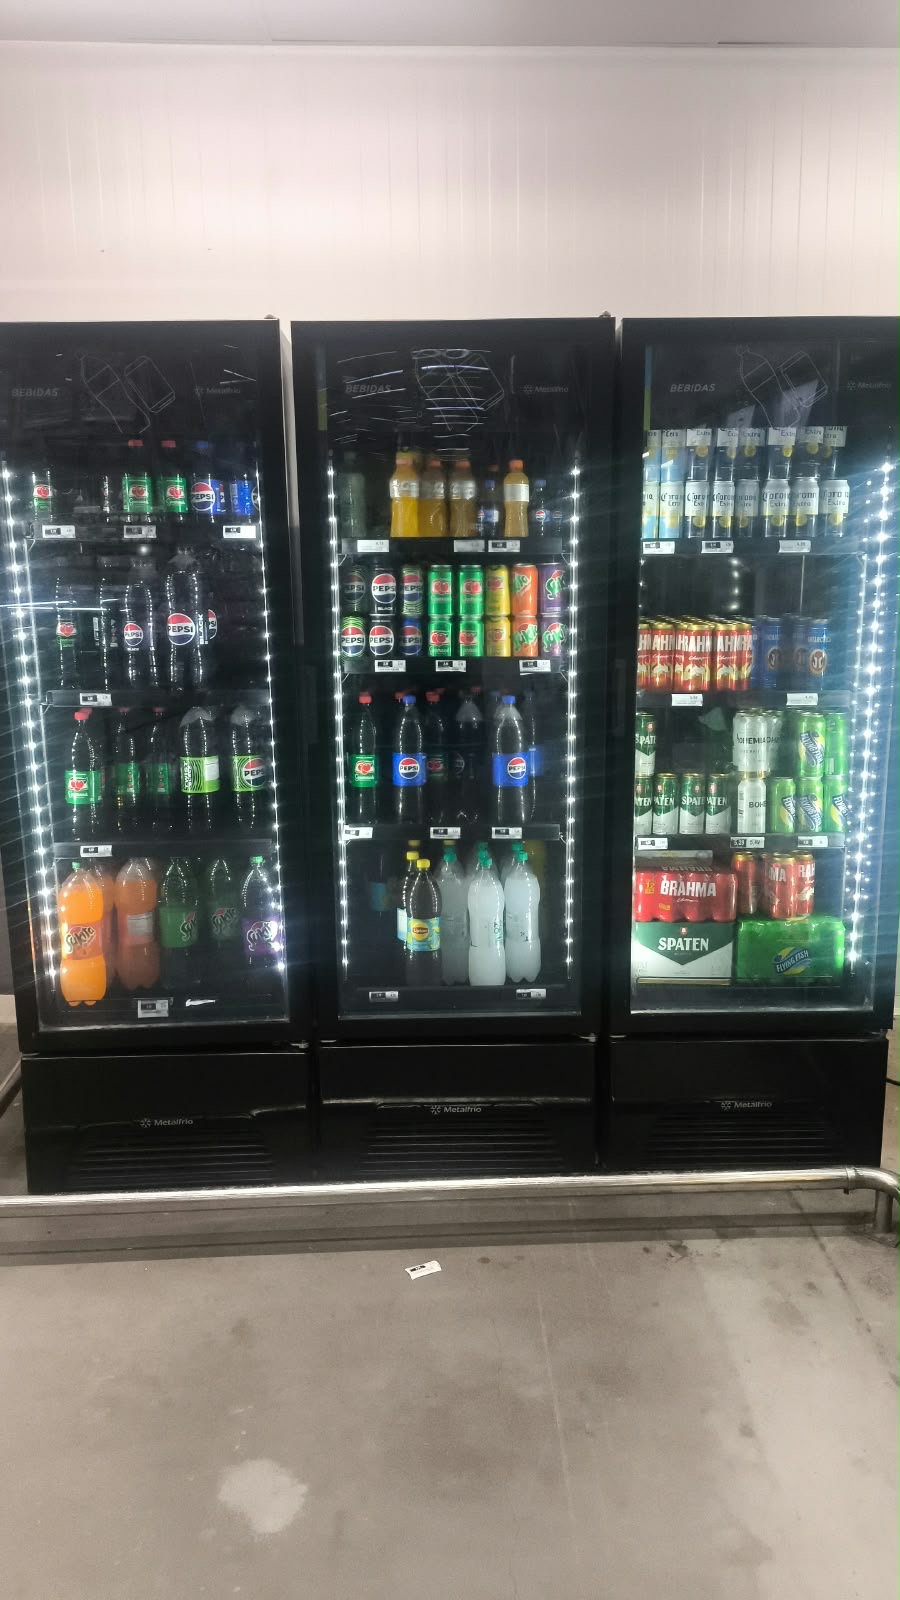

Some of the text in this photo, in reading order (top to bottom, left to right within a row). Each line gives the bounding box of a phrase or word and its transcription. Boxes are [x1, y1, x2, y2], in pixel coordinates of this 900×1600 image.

[11, 387, 58, 397] BEBIDAS
[345, 384, 391, 394] BEBIDAS
[670, 383, 716, 393] BEBIDAS
[168, 625, 194, 633] PEPSI
[660, 880, 717, 898] BRAHMA
[658, 937, 709, 951] SPATEN
[776, 949, 809, 974] FLYING FISH
[153, 1118, 194, 1126] Metalfrio
